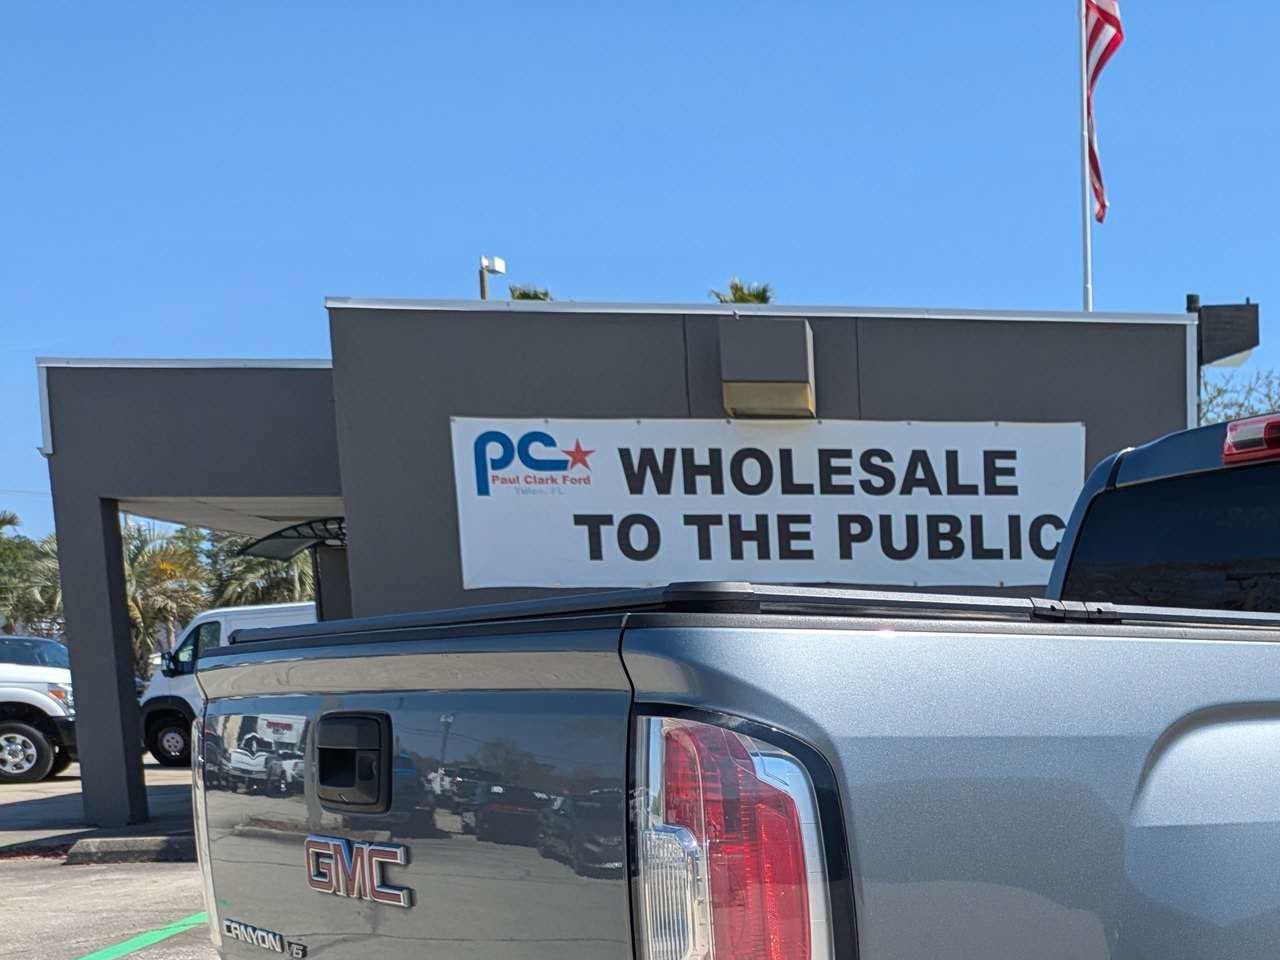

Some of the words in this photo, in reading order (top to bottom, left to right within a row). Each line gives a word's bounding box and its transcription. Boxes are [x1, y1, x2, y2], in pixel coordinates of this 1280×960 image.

[491, 474, 520, 485] Paul
[523, 474, 558, 485] Clark
[562, 474, 592, 486] Ford
[617, 446, 1019, 497] WHOLESALE
[573, 513, 661, 562] TO
[683, 513, 813, 561] THE
[837, 513, 1065, 561] PUBLIC
[304, 833, 412, 908] GMC
[223, 918, 284, 953] CANYON
